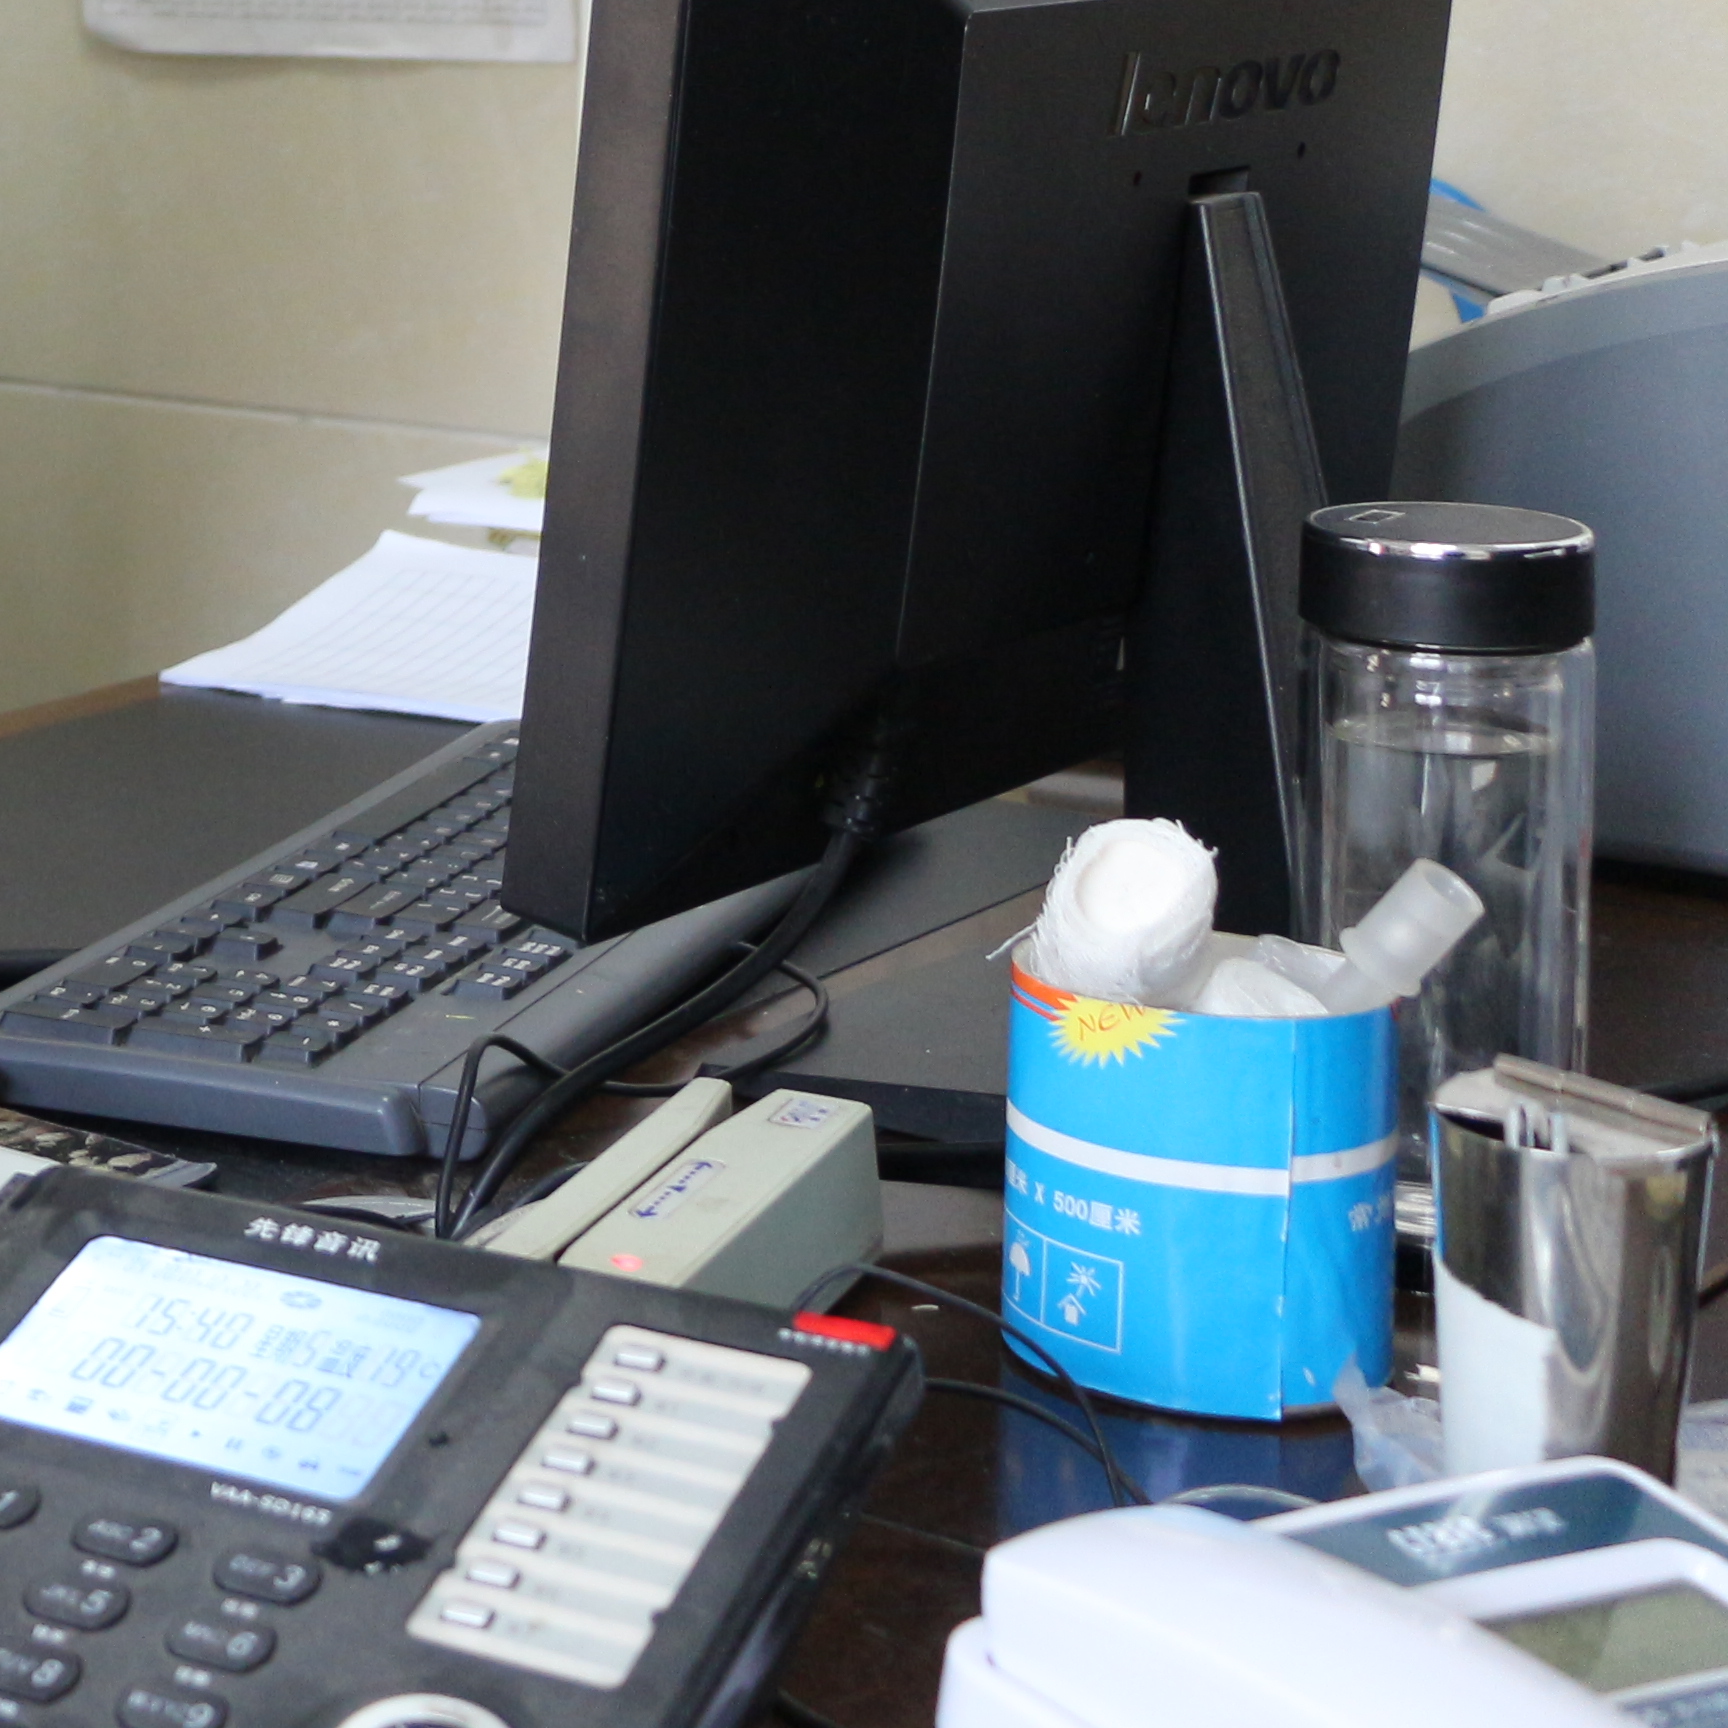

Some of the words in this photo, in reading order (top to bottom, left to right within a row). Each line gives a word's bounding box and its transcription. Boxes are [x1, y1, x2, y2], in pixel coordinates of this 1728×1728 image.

[1107, 49, 1341, 136] lenovo
[1052, 1190, 1142, 1235] 500厘米
[243, 1216, 382, 1264] 先锋音讯
[135, 1295, 255, 1350] 15:40
[70, 1336, 342, 1432] 00-00-08
[129, 1526, 163, 1552] 2
[273, 1564, 306, 1590] 3
[80, 1589, 114, 1615] 5
[226, 1631, 258, 1659] 6
[31, 1659, 64, 1688] 8
[183, 1703, 215, 1728] 9
